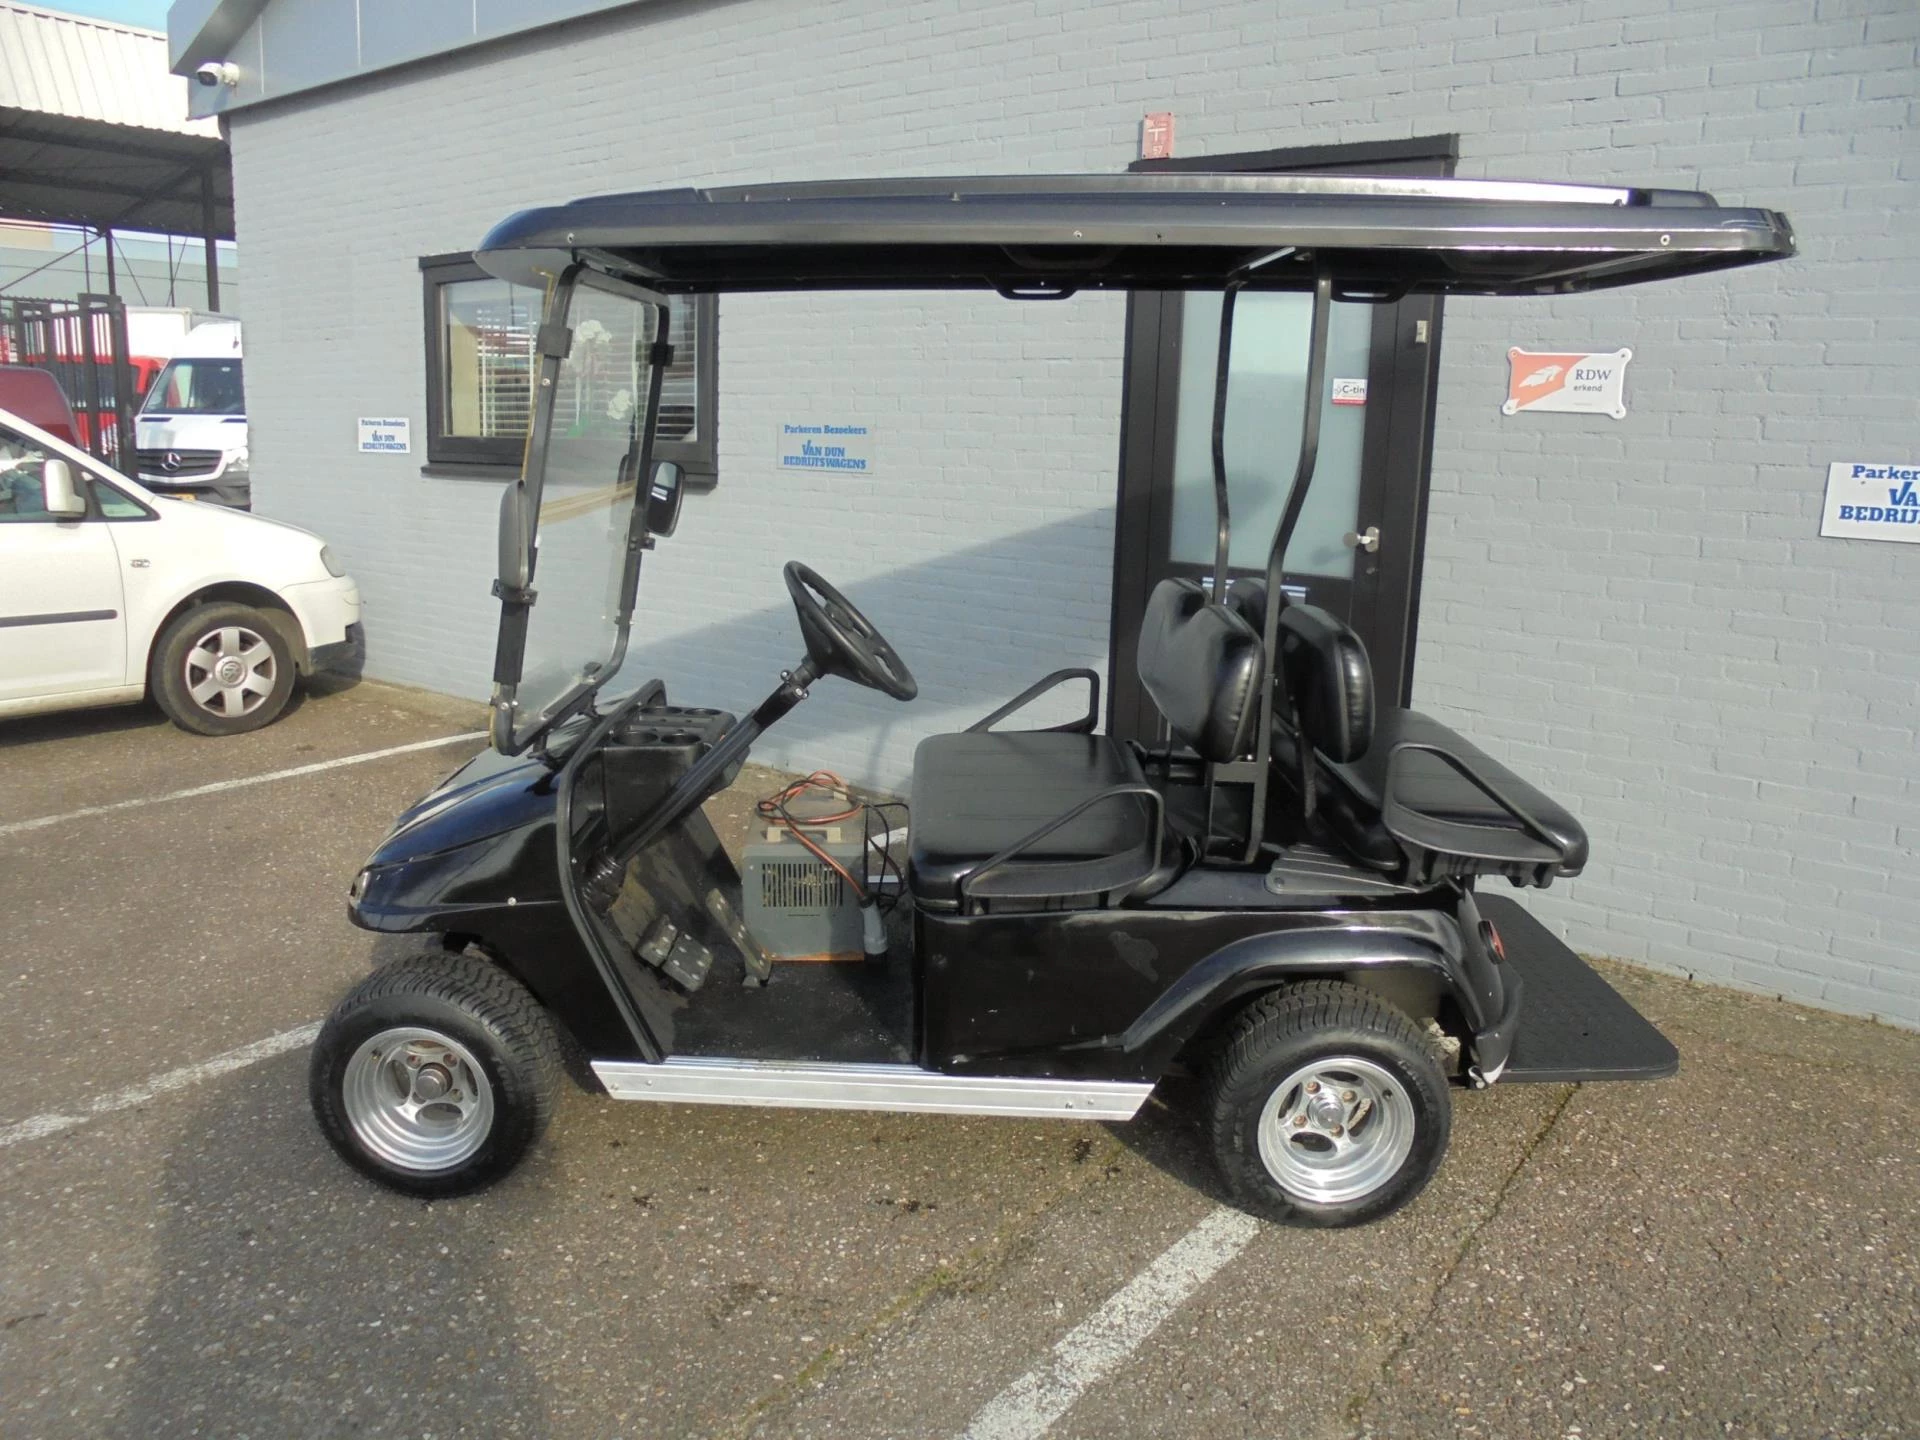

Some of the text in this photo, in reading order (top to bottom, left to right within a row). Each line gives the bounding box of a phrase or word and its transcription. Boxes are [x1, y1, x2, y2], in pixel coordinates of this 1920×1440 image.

[1575, 368, 1612, 381] RDW
[1573, 384, 1603, 392] erkend
[784, 425, 822, 434] Parkeren
[802, 440, 846, 458] VAN DUN
[783, 455, 867, 470] BEDRIJFSWAGENS
[1838, 504, 1920, 524] BEDRIJ
